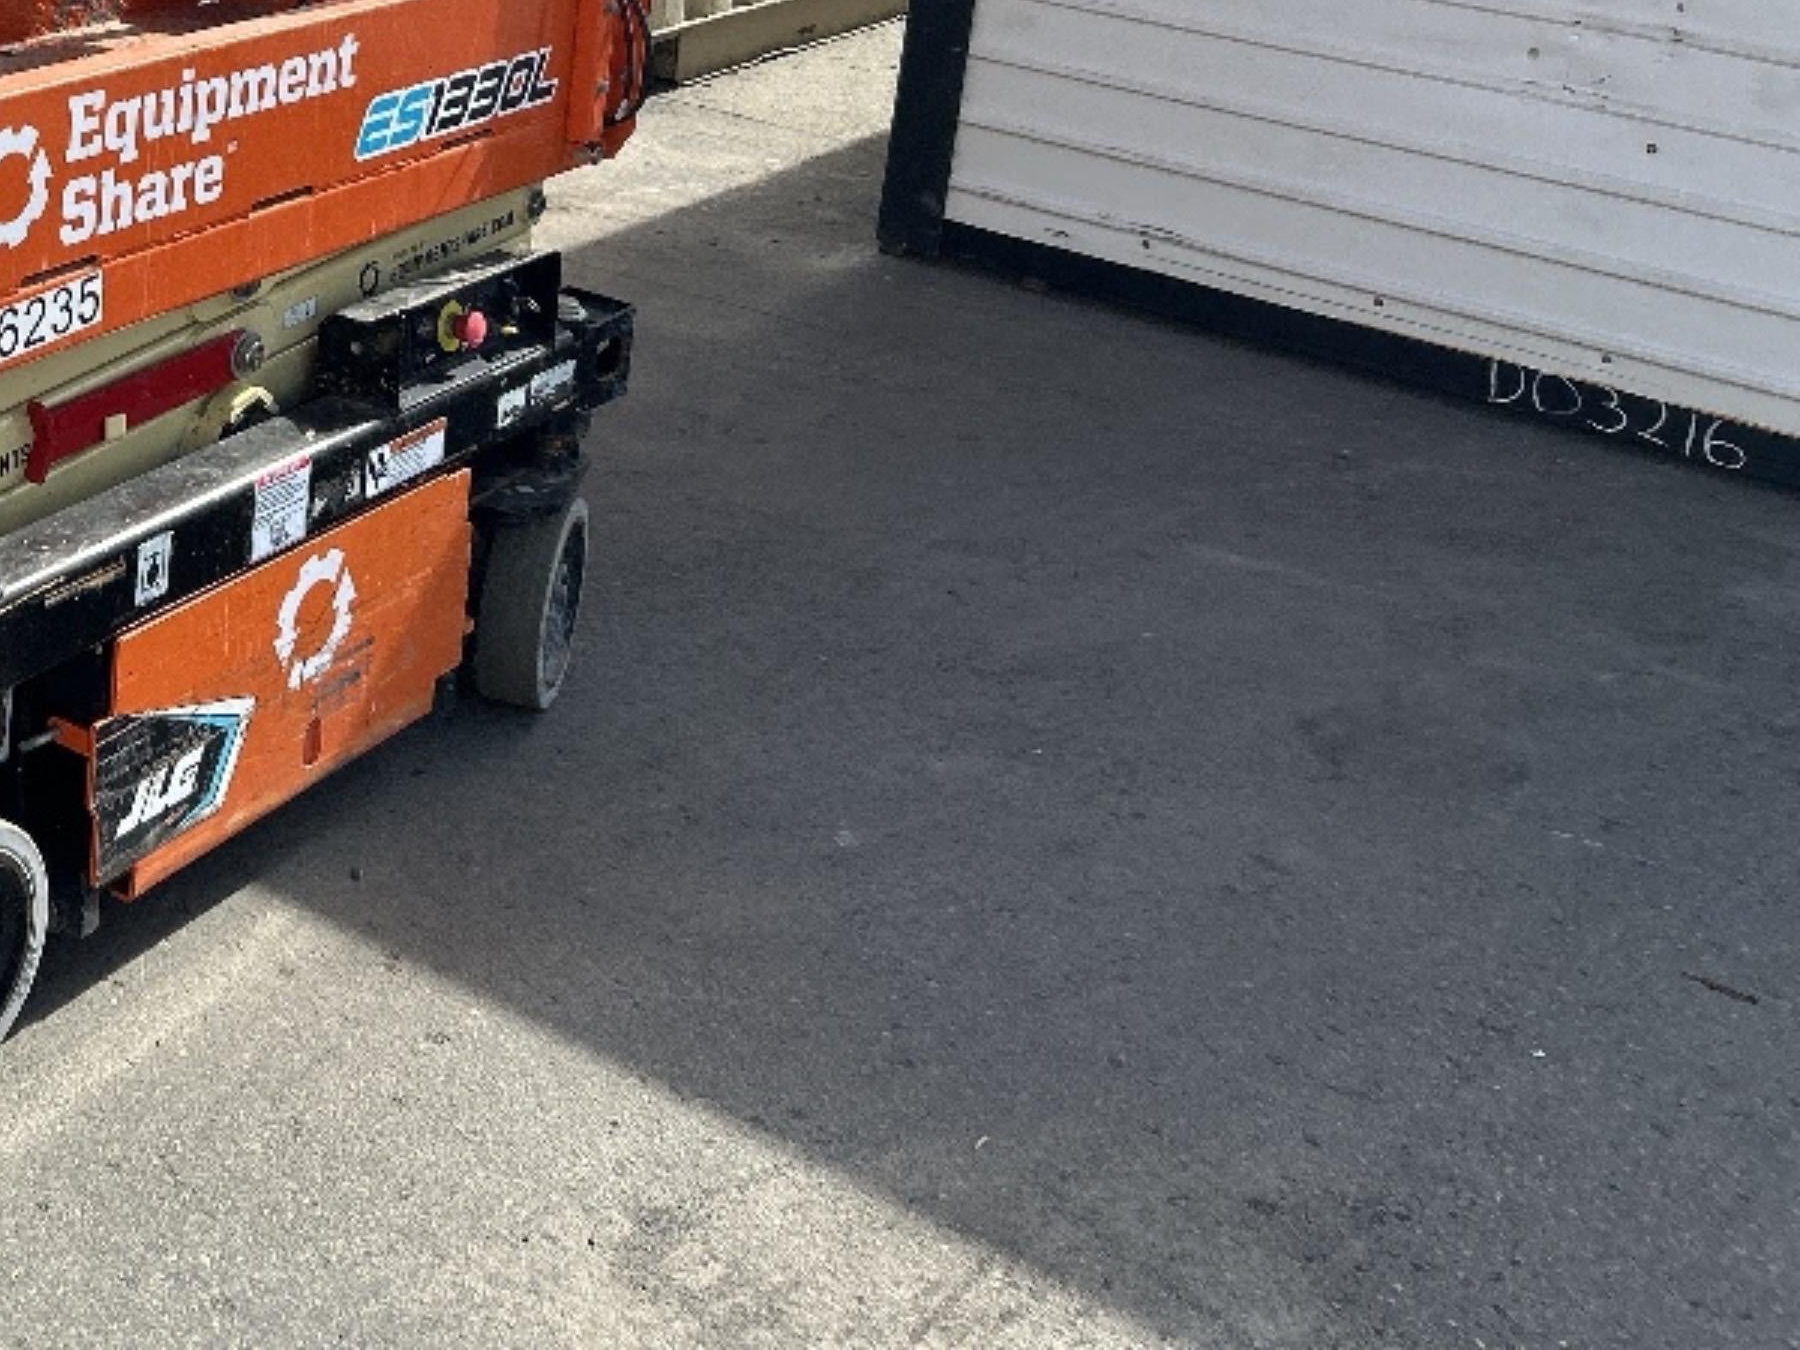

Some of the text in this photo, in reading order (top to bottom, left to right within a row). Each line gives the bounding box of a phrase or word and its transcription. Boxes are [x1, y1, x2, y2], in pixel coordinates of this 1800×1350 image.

[63, 32, 360, 162] Equipment
[354, 45, 559, 162] ES1330L
[58, 155, 224, 247] Share
[112, 743, 206, 842] JLG
